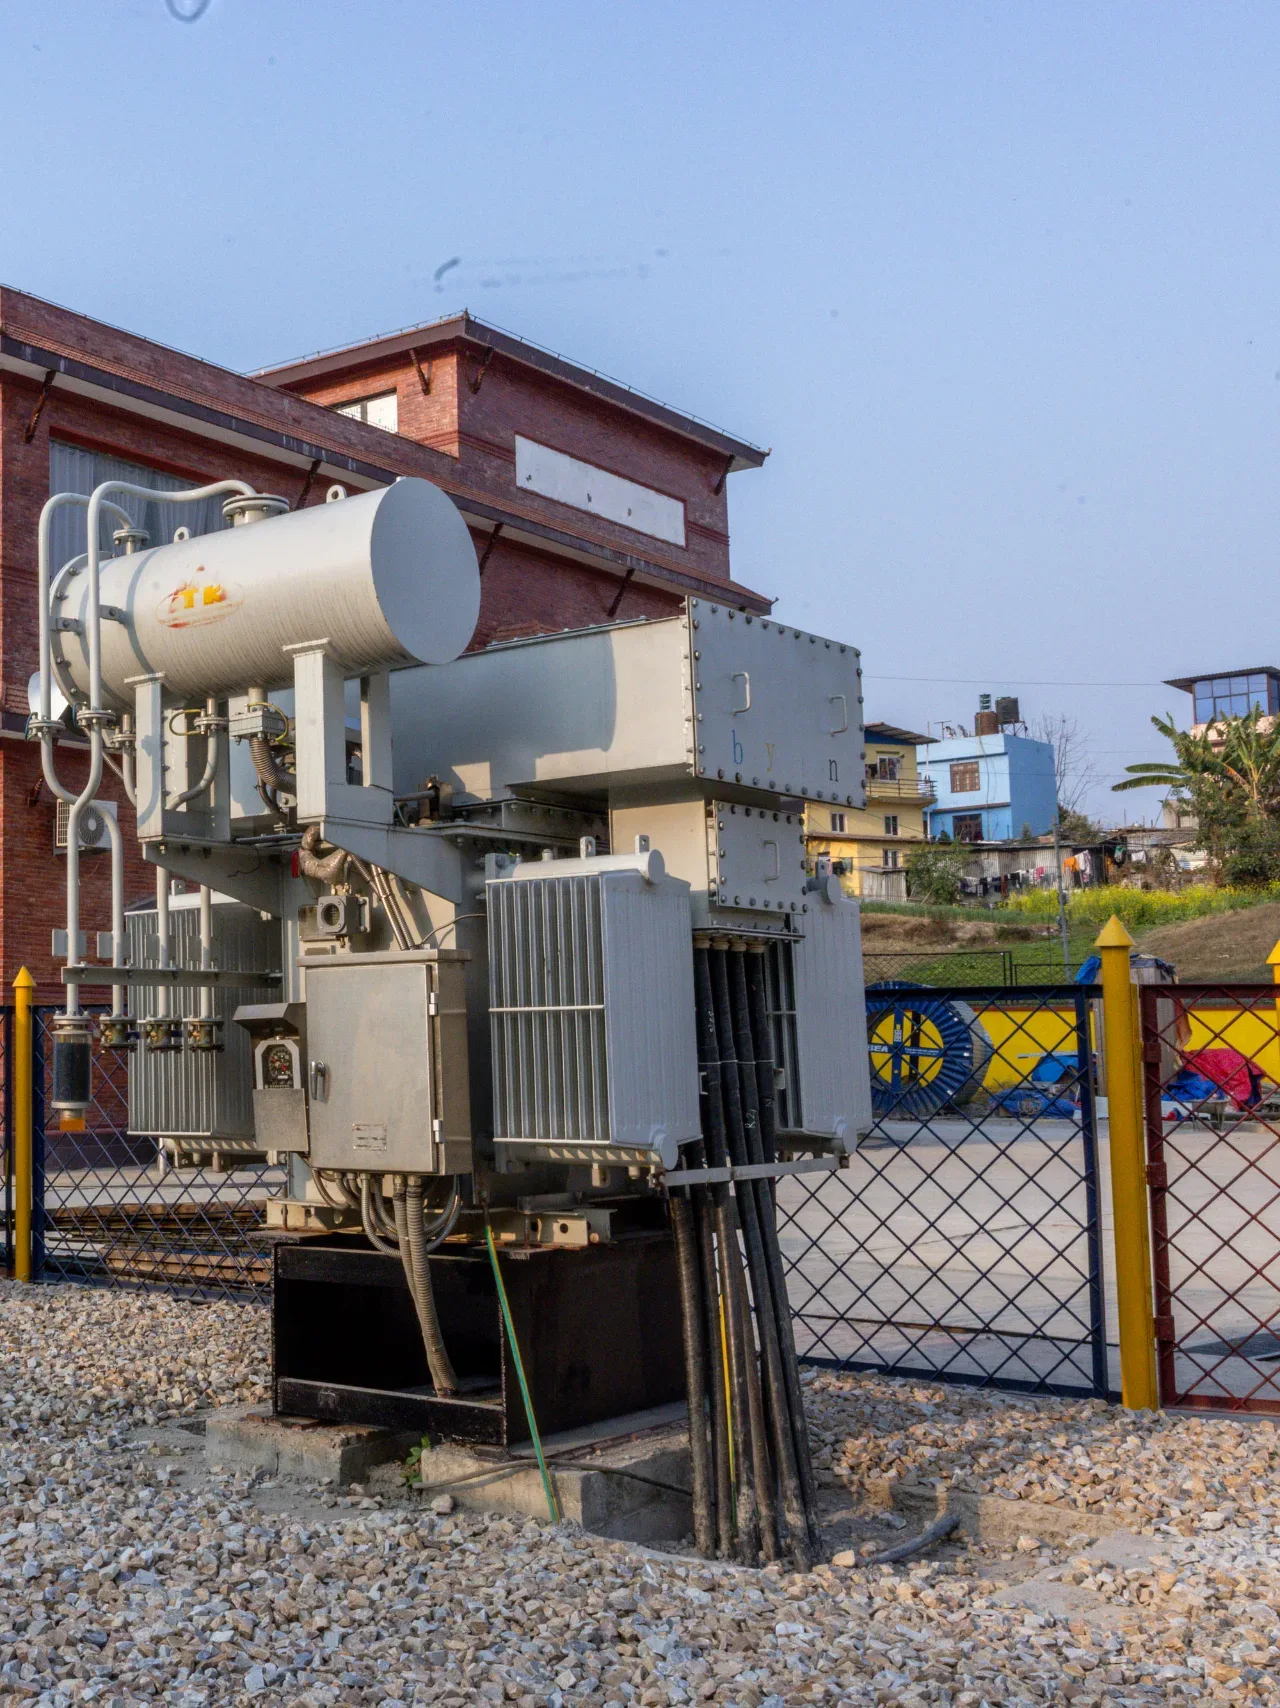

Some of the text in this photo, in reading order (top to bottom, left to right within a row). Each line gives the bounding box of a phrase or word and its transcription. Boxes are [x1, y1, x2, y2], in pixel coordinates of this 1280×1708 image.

[731, 729, 744, 765] b
[765, 742, 776, 772] y
[828, 758, 839, 782] n
